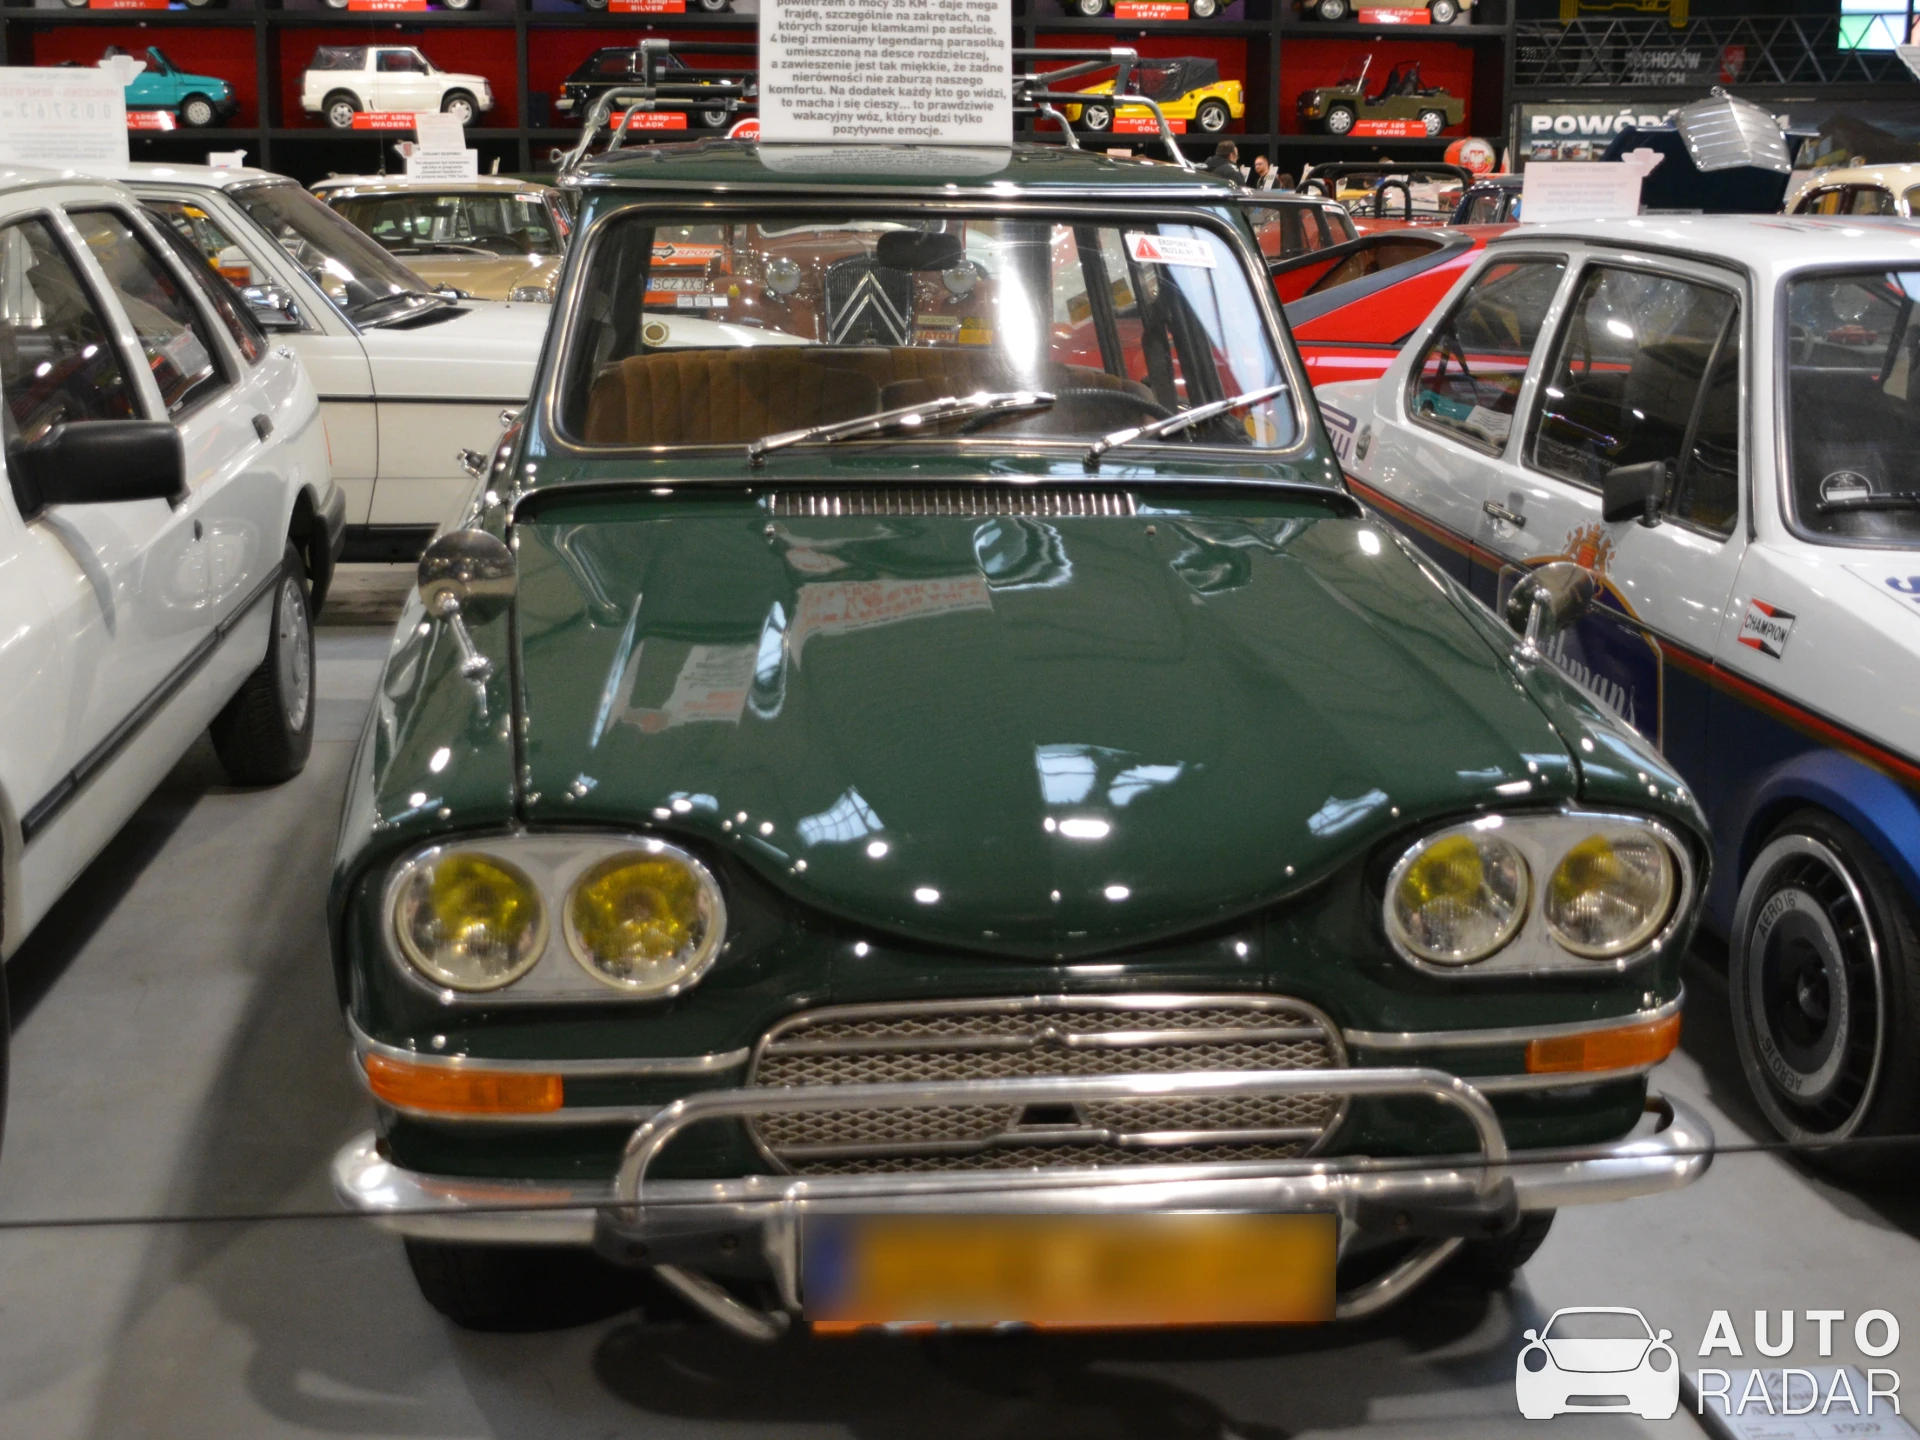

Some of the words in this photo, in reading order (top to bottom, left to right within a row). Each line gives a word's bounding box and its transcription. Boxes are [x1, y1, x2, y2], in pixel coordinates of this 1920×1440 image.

[784, 9, 823, 20] frajdę,
[825, 10, 893, 22] szczególnie
[913, 12, 973, 24] zakrętach,
[778, 22, 822, 33] których
[825, 23, 868, 34] szoruje
[871, 24, 929, 34] klamkami
[949, 25, 997, 35] asfalcie.
[781, 34, 808, 45] biegi
[811, 35, 874, 47] zmieniamy
[878, 36, 944, 48] legendarną
[947, 38, 1004, 49] parasolką
[786, 47, 861, 59] umieszczoną
[881, 49, 914, 59] desce
[917, 50, 990, 62] rozdzielczej,
[781, 60, 851, 70] zawieszenie
[854, 61, 876, 72] jest
[880, 62, 897, 71] tak
[901, 62, 950, 73] miękkie,
[969, 63, 1003, 73] żadne
[792, 73, 862, 83] nierówności
[866, 74, 883, 83] nie
[886, 74, 932, 86] zaburzą
[936, 77, 983, 88] naszego
[768, 85, 826, 95] komfortu.
[849, 86, 895, 96] dodatek
[898, 87, 932, 98] każdy
[935, 88, 953, 97] kto
[973, 88, 1006, 100] widzi,
[796, 98, 834, 108] macha
[844, 99, 861, 110] się
[864, 99, 910, 111] cieszy...
[928, 100, 994, 112] prawdziwie
[793, 111, 853, 122] wakacyjny
[857, 112, 883, 123] wóz,
[886, 112, 916, 123] który
[920, 113, 950, 122] budzi
[954, 113, 982, 124] tylko
[833, 124, 894, 136] pozytywne
[898, 125, 943, 136] emocje.
[653, 278, 678, 290] SCZ
[1744, 614, 1788, 644] CHAMPION
